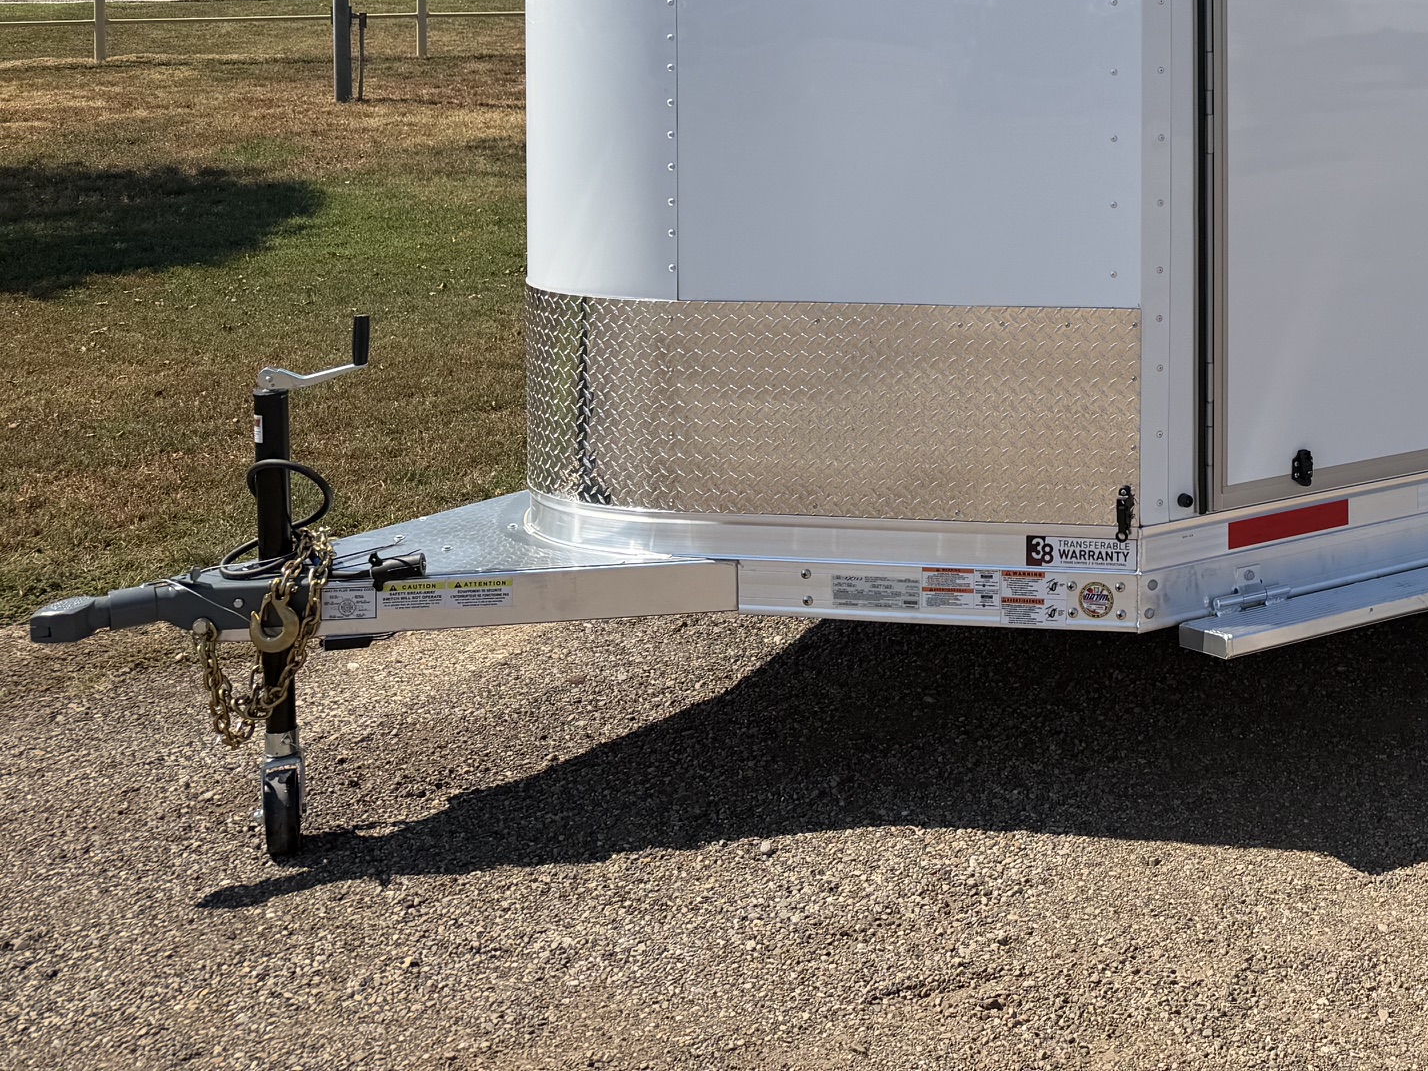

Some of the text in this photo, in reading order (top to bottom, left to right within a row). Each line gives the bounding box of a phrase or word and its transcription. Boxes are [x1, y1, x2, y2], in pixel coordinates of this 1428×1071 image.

[1058, 539, 1130, 551] TRANSFERABLE
[1058, 548, 1130, 562] WARRANTY
[463, 580, 507, 588] ATTENTION
